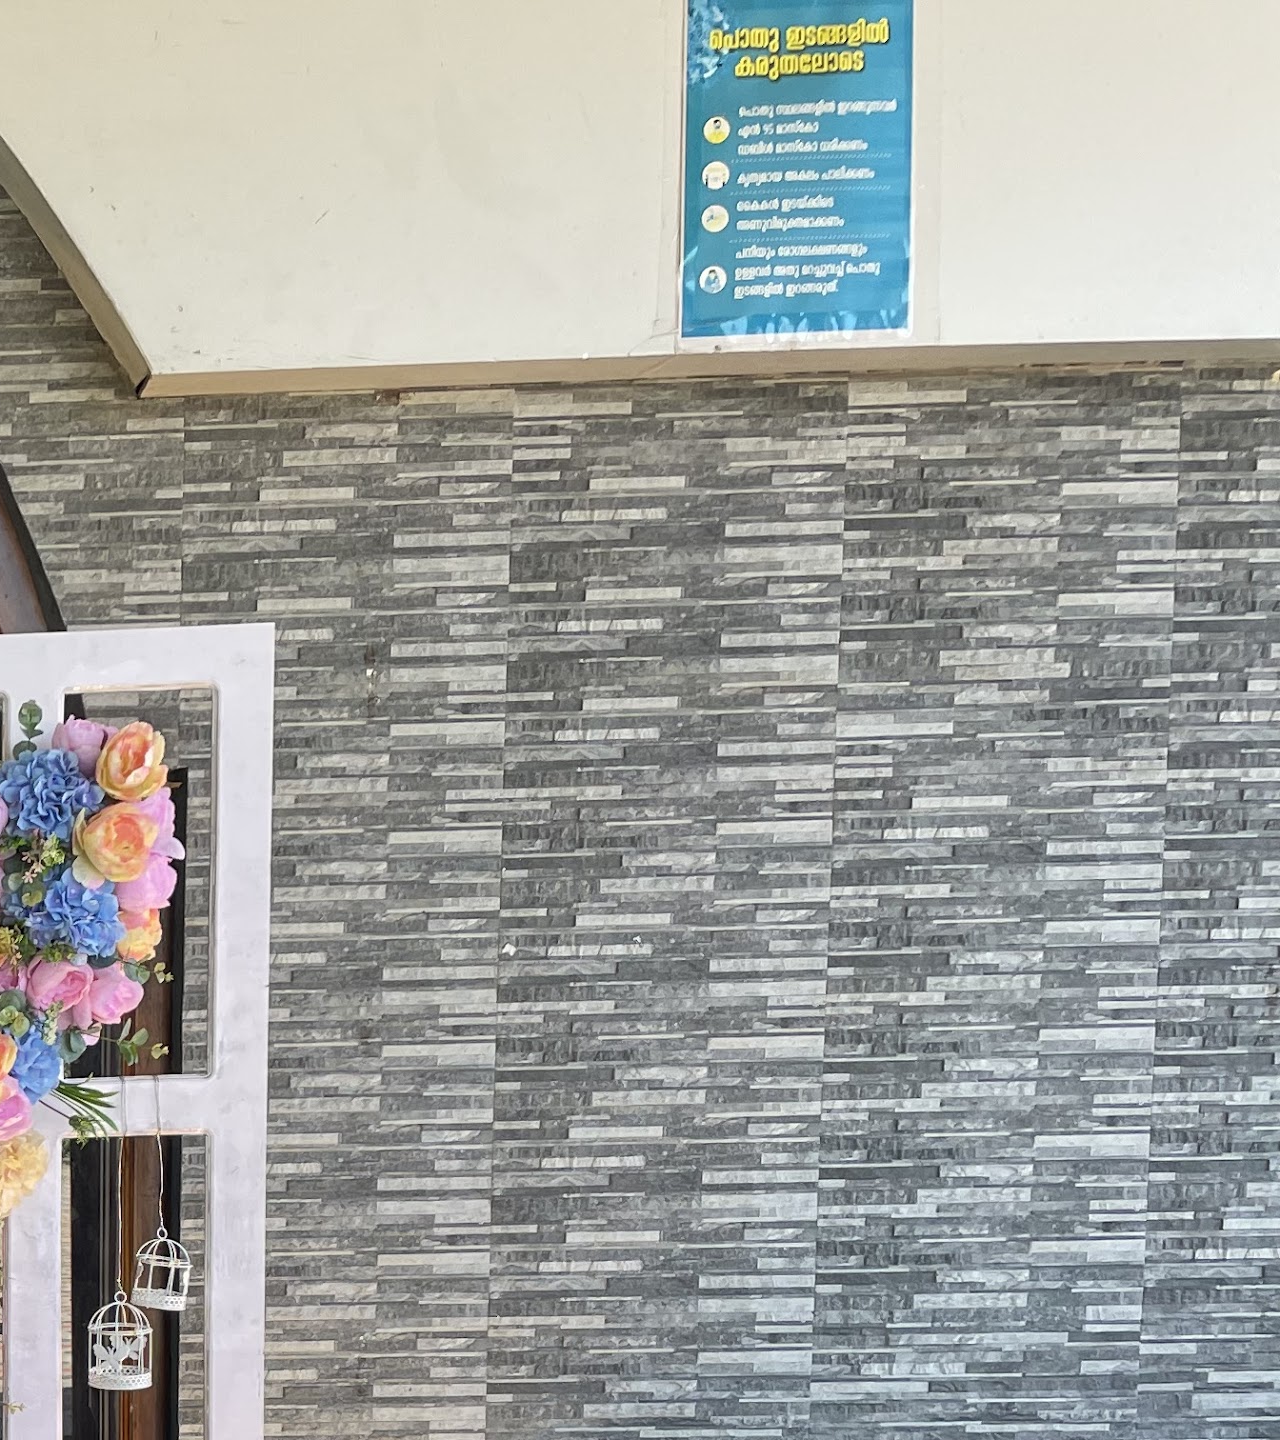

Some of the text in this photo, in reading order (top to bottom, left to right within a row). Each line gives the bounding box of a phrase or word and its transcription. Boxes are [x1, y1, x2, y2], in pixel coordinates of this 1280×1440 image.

[709, 17, 890, 53] പൊതു ഇടങ്ങളിൽ
[735, 50, 864, 81] കരുതലോടെ
